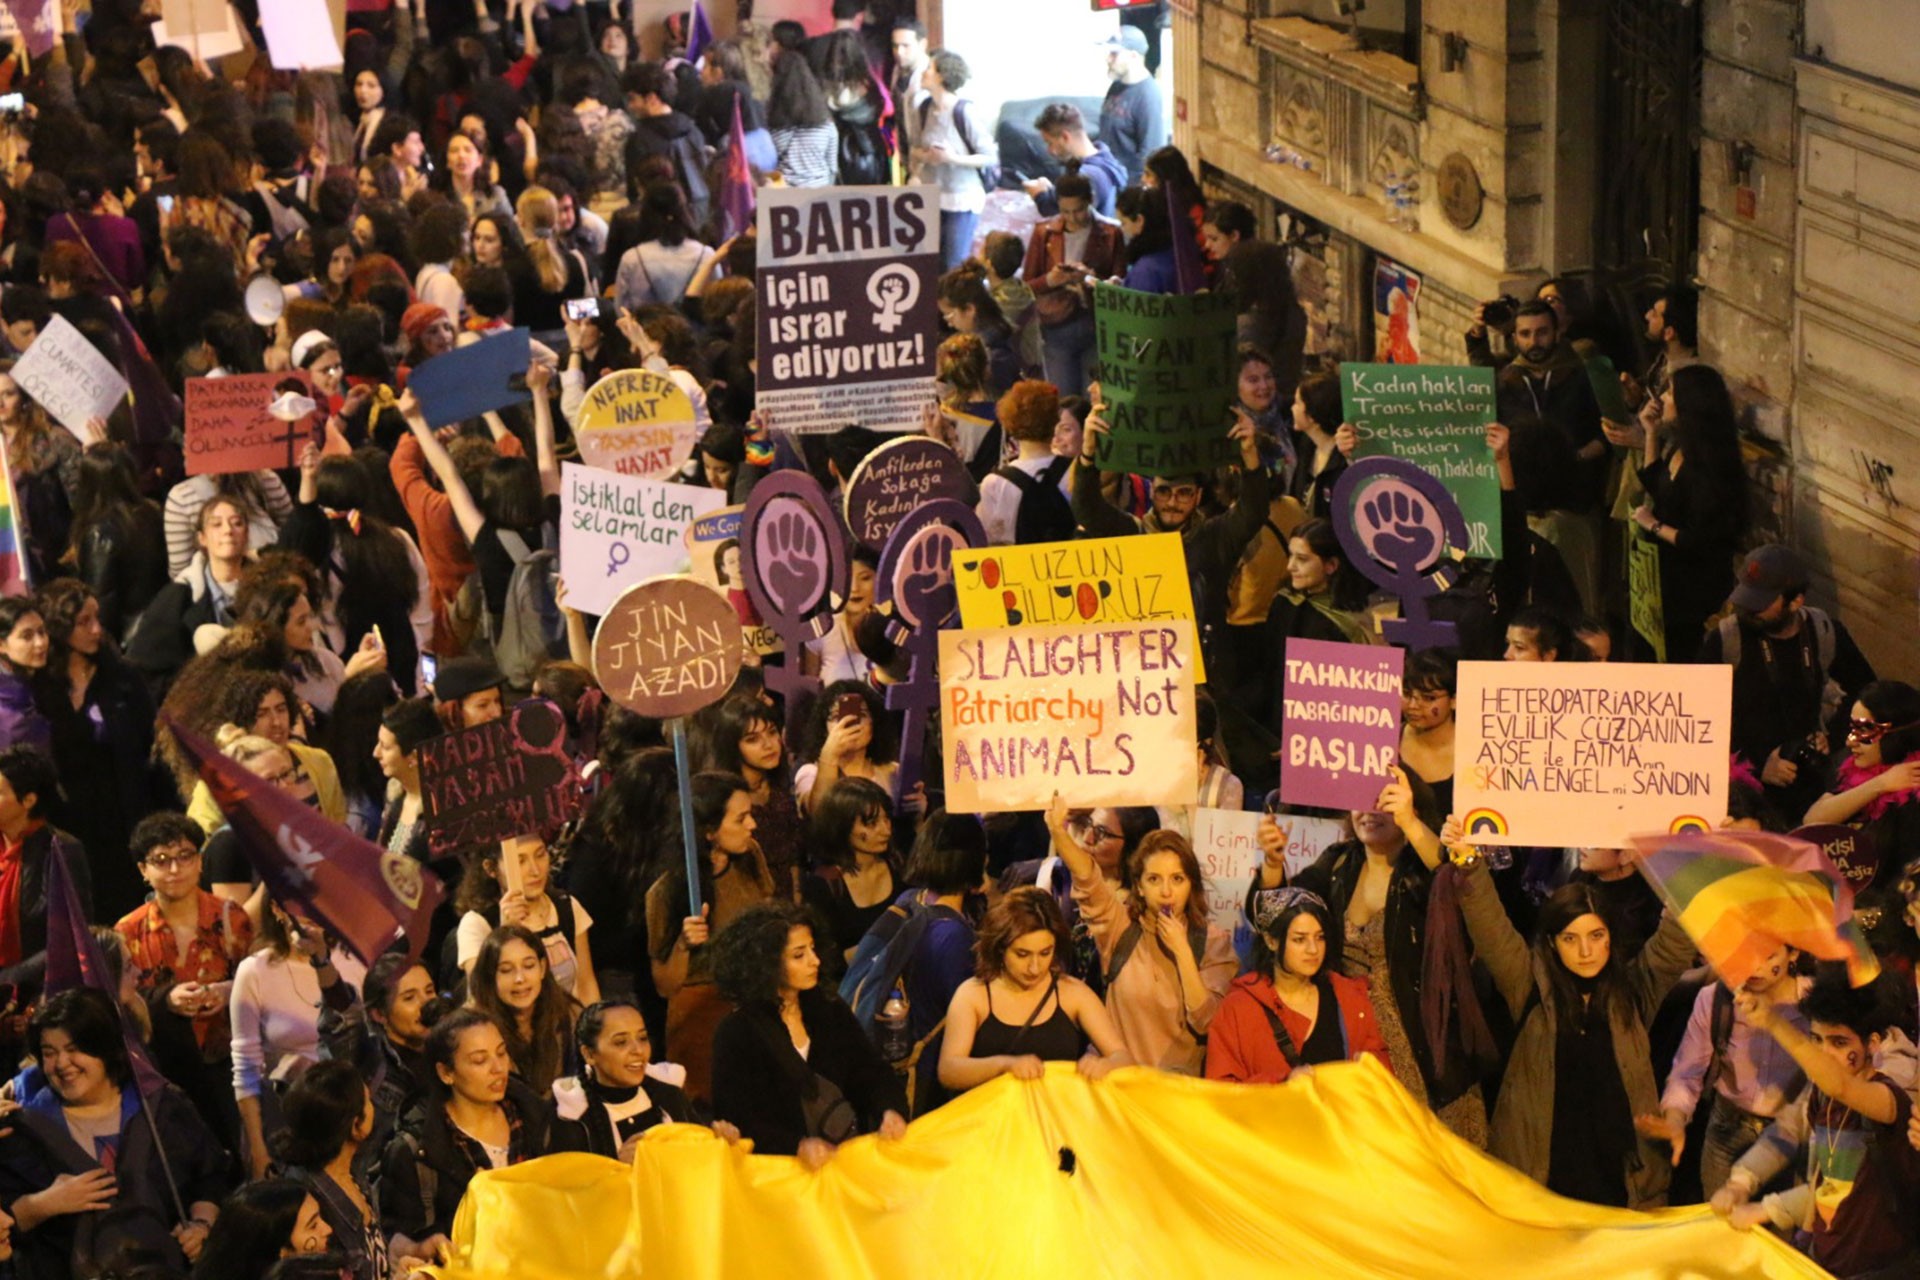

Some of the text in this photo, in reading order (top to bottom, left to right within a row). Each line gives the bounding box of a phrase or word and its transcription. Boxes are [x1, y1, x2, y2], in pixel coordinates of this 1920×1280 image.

[769, 192, 926, 259] BARIŞ
[766, 271, 830, 310] için
[769, 310, 847, 344] ısrar
[772, 333, 925, 380] ediyoruz!
[591, 373, 677, 411] NEFRETE
[1351, 371, 1492, 395] Kadın hakları
[1352, 398, 1492, 416] Trans hakları
[1355, 420, 1415, 440] Seks
[615, 447, 673, 475] HAYAT
[1392, 441, 1459, 455] hakları
[862, 452, 943, 486] Amfilerden
[881, 473, 942, 494] Sokağa
[1444, 457, 1496, 480] hakları
[572, 510, 679, 546] selamlar
[696, 523, 716, 537] We
[1031, 544, 1124, 582] UZUN
[956, 628, 1183, 682] SLAUGHTER
[1285, 659, 1403, 696] TAHAKKÜM
[950, 676, 1179, 738] Patriarchy Not
[1283, 698, 1395, 729] TABAĞINDA
[1580, 715, 1714, 744] CÜZDANINIZ
[954, 732, 1136, 783] ANIMALS
[1289, 733, 1397, 780] BAŞLAR
[1476, 740, 1532, 768] AYŞE
[1543, 740, 1564, 767] ile
[1544, 767, 1610, 795] ENGEL
[1613, 786, 1627, 795] mi
[1632, 770, 1710, 796] SANDIN
